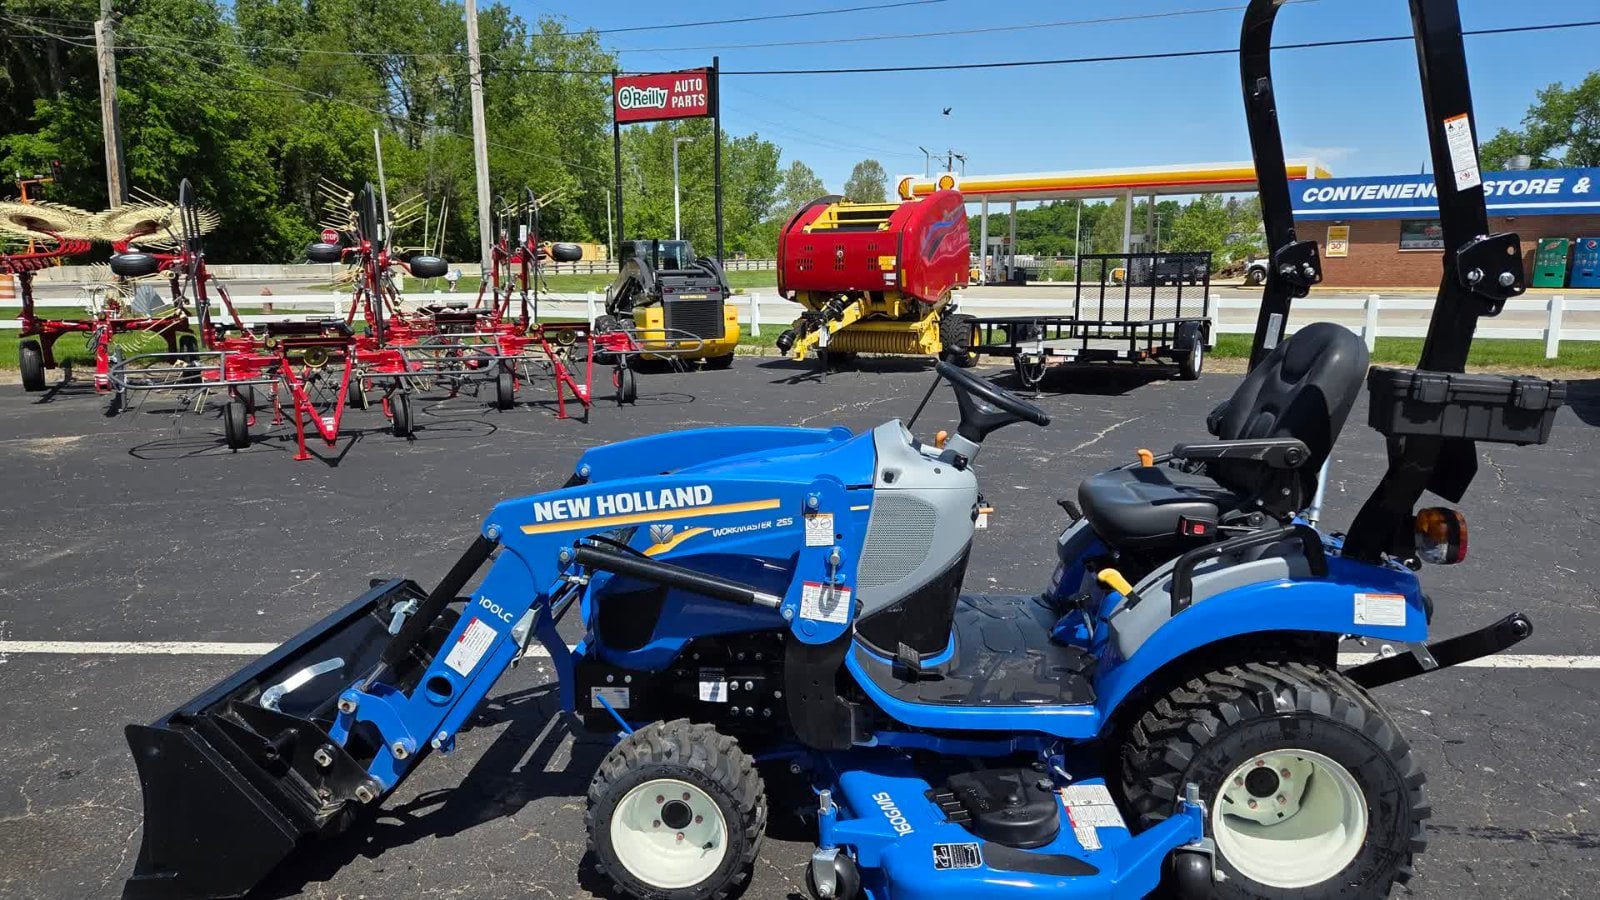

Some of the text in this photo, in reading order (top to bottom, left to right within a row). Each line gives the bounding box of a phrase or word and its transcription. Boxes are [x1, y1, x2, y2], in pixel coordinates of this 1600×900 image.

[674, 78, 703, 93] AUTO
[619, 87, 667, 108] O'Reilly
[671, 94, 705, 108] PARTS
[1302, 177, 1591, 203] CONVENIEN STORE &
[322, 233, 337, 241] STOP
[533, 485, 714, 522] NEW HOLLAND
[712, 520, 772, 537] WORKMASTER
[478, 595, 514, 623] 100LC
